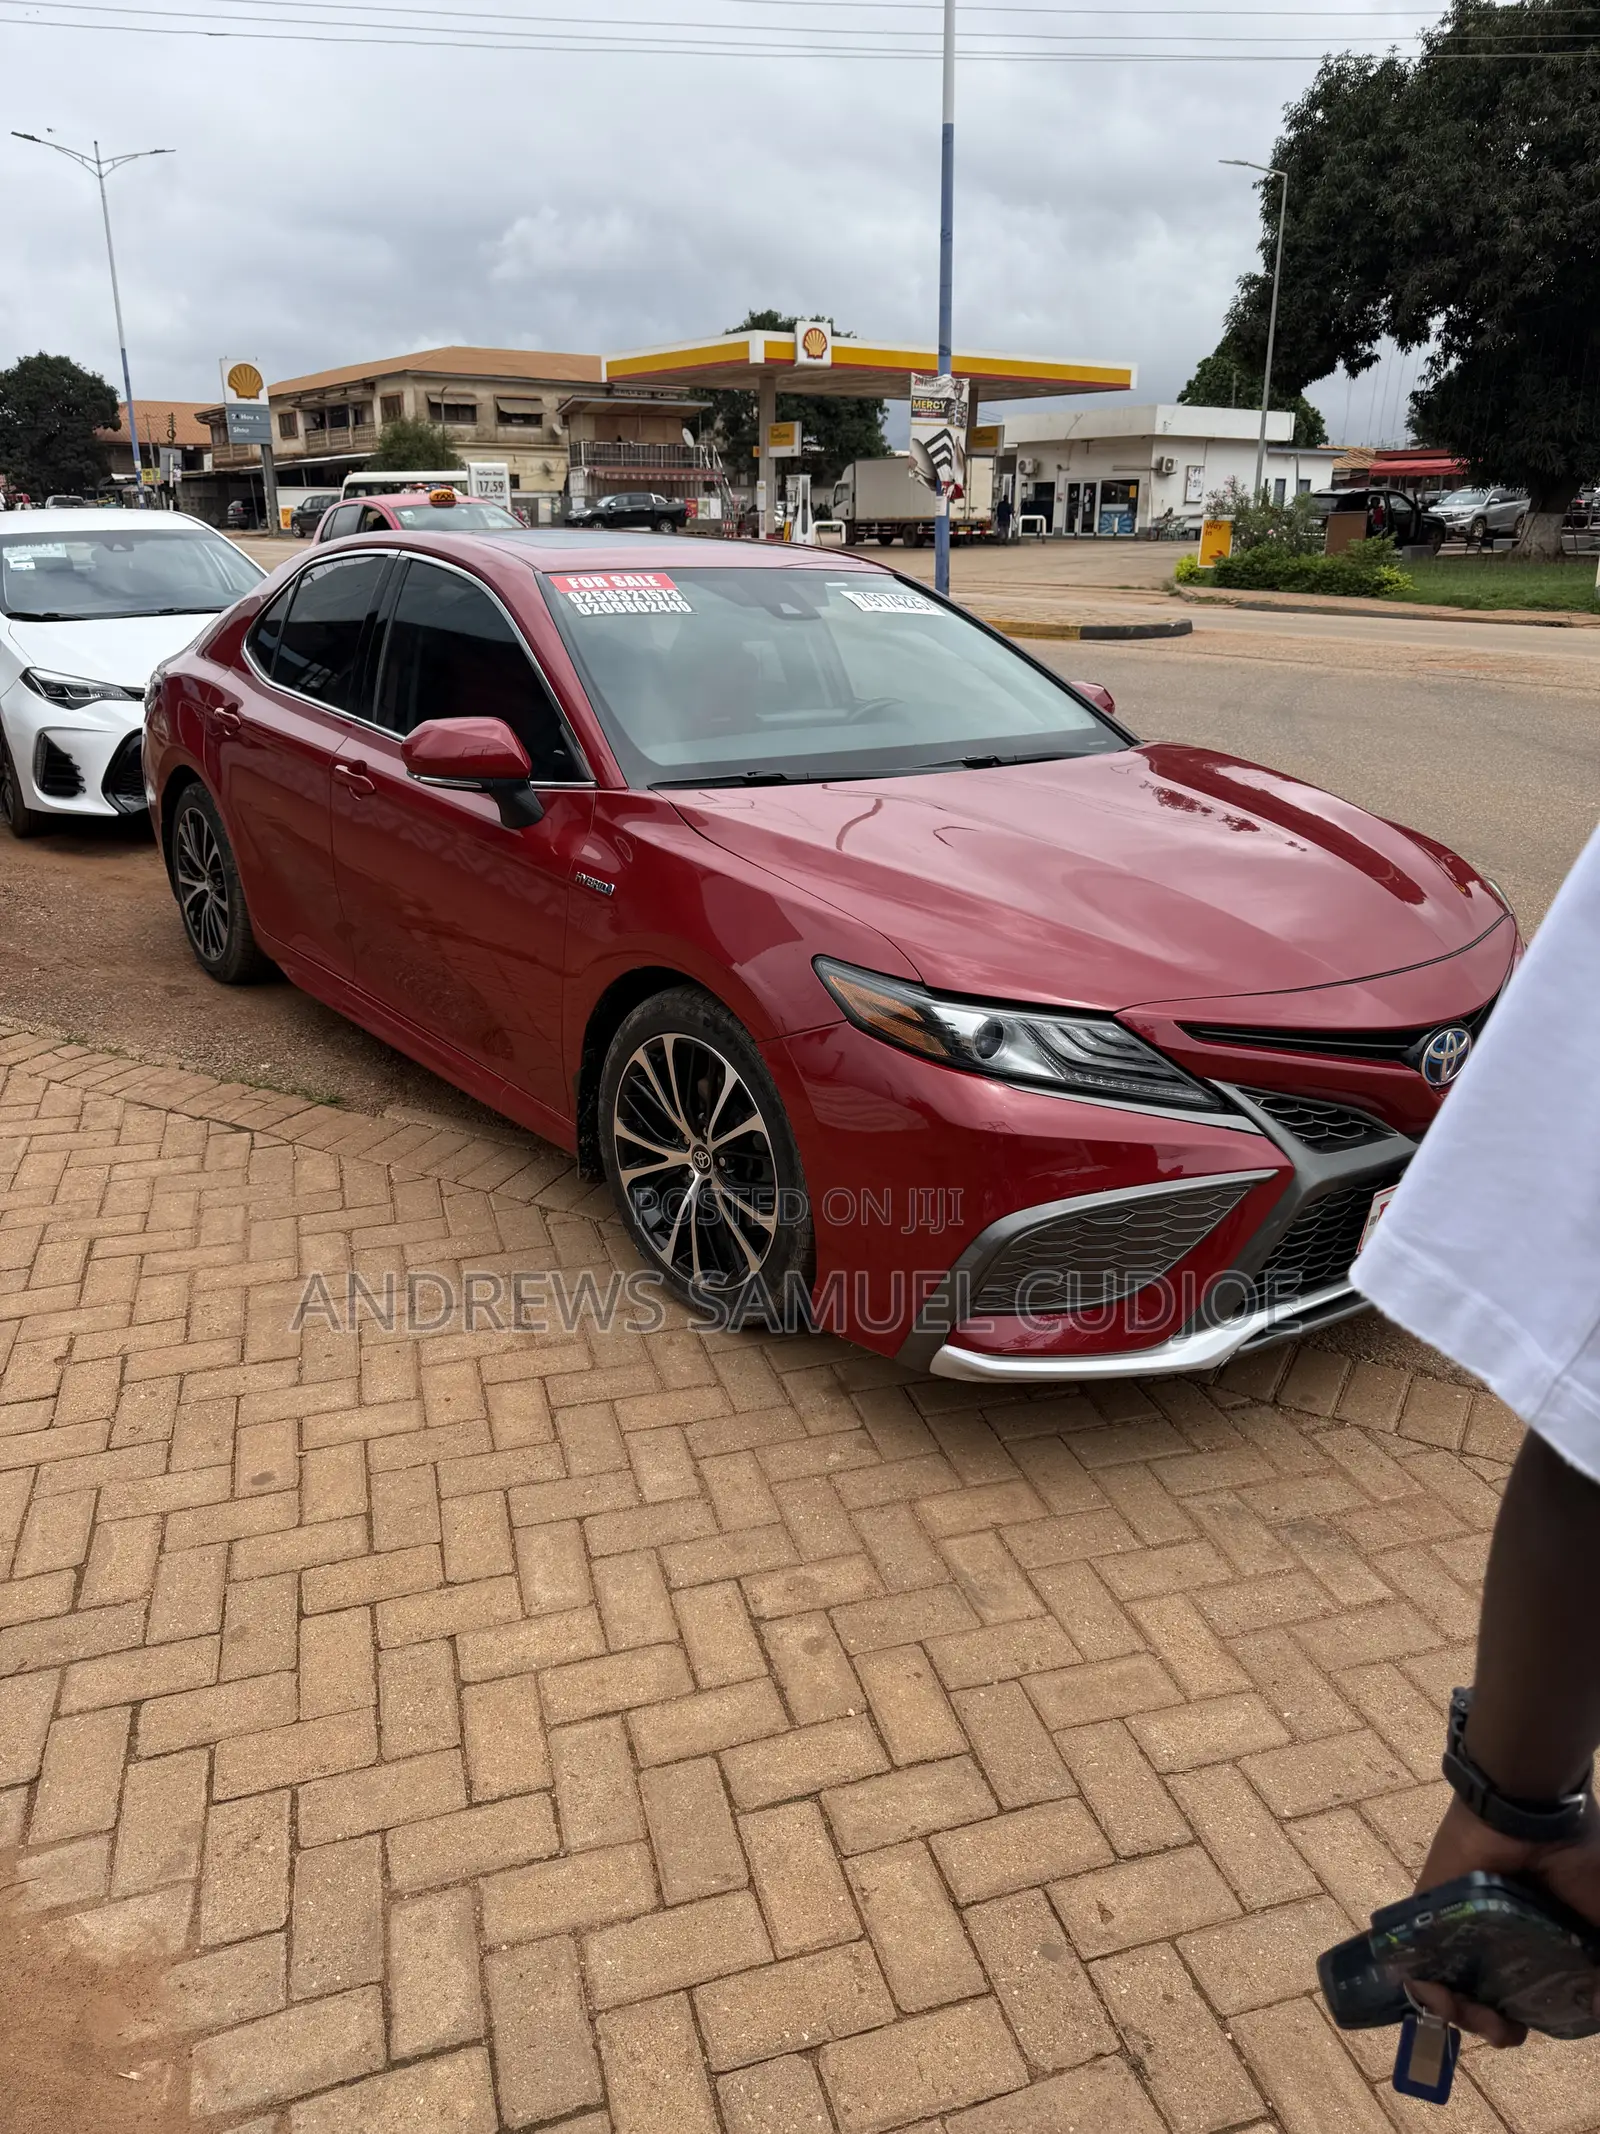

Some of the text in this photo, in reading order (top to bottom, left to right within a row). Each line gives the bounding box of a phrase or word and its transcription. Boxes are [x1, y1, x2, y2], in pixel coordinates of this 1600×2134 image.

[912, 400, 947, 409] MERCY
[479, 480, 504, 492] 17.59
[434, 492, 455, 500] TAXI
[1206, 521, 1223, 530] Way
[566, 575, 661, 589] FOR SALE
[567, 590, 683, 604] 0256321573
[576, 601, 692, 615] 0209802440
[575, 871, 616, 896] HYBRID
